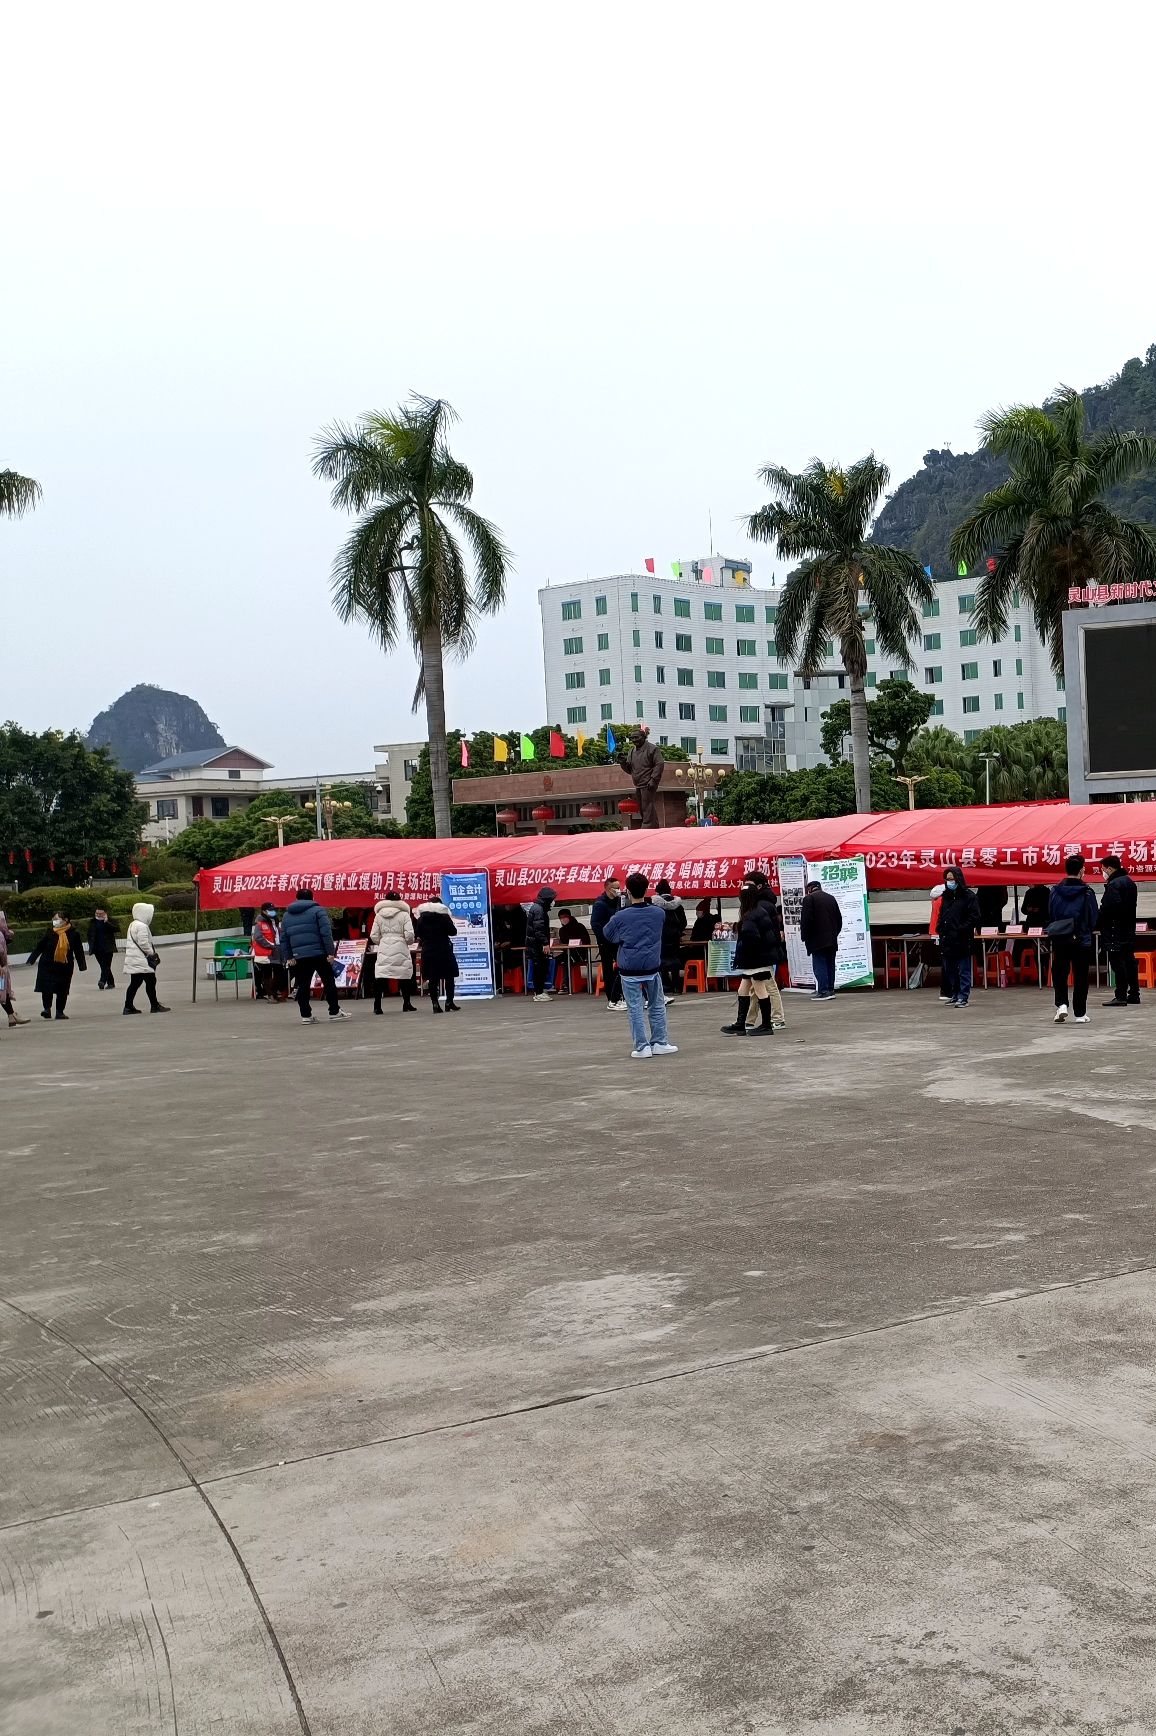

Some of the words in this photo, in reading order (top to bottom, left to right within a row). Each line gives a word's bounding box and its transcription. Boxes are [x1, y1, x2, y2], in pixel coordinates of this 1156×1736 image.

[821, 865, 858, 883] 招聘
[449, 884, 482, 896] 恒企会计
